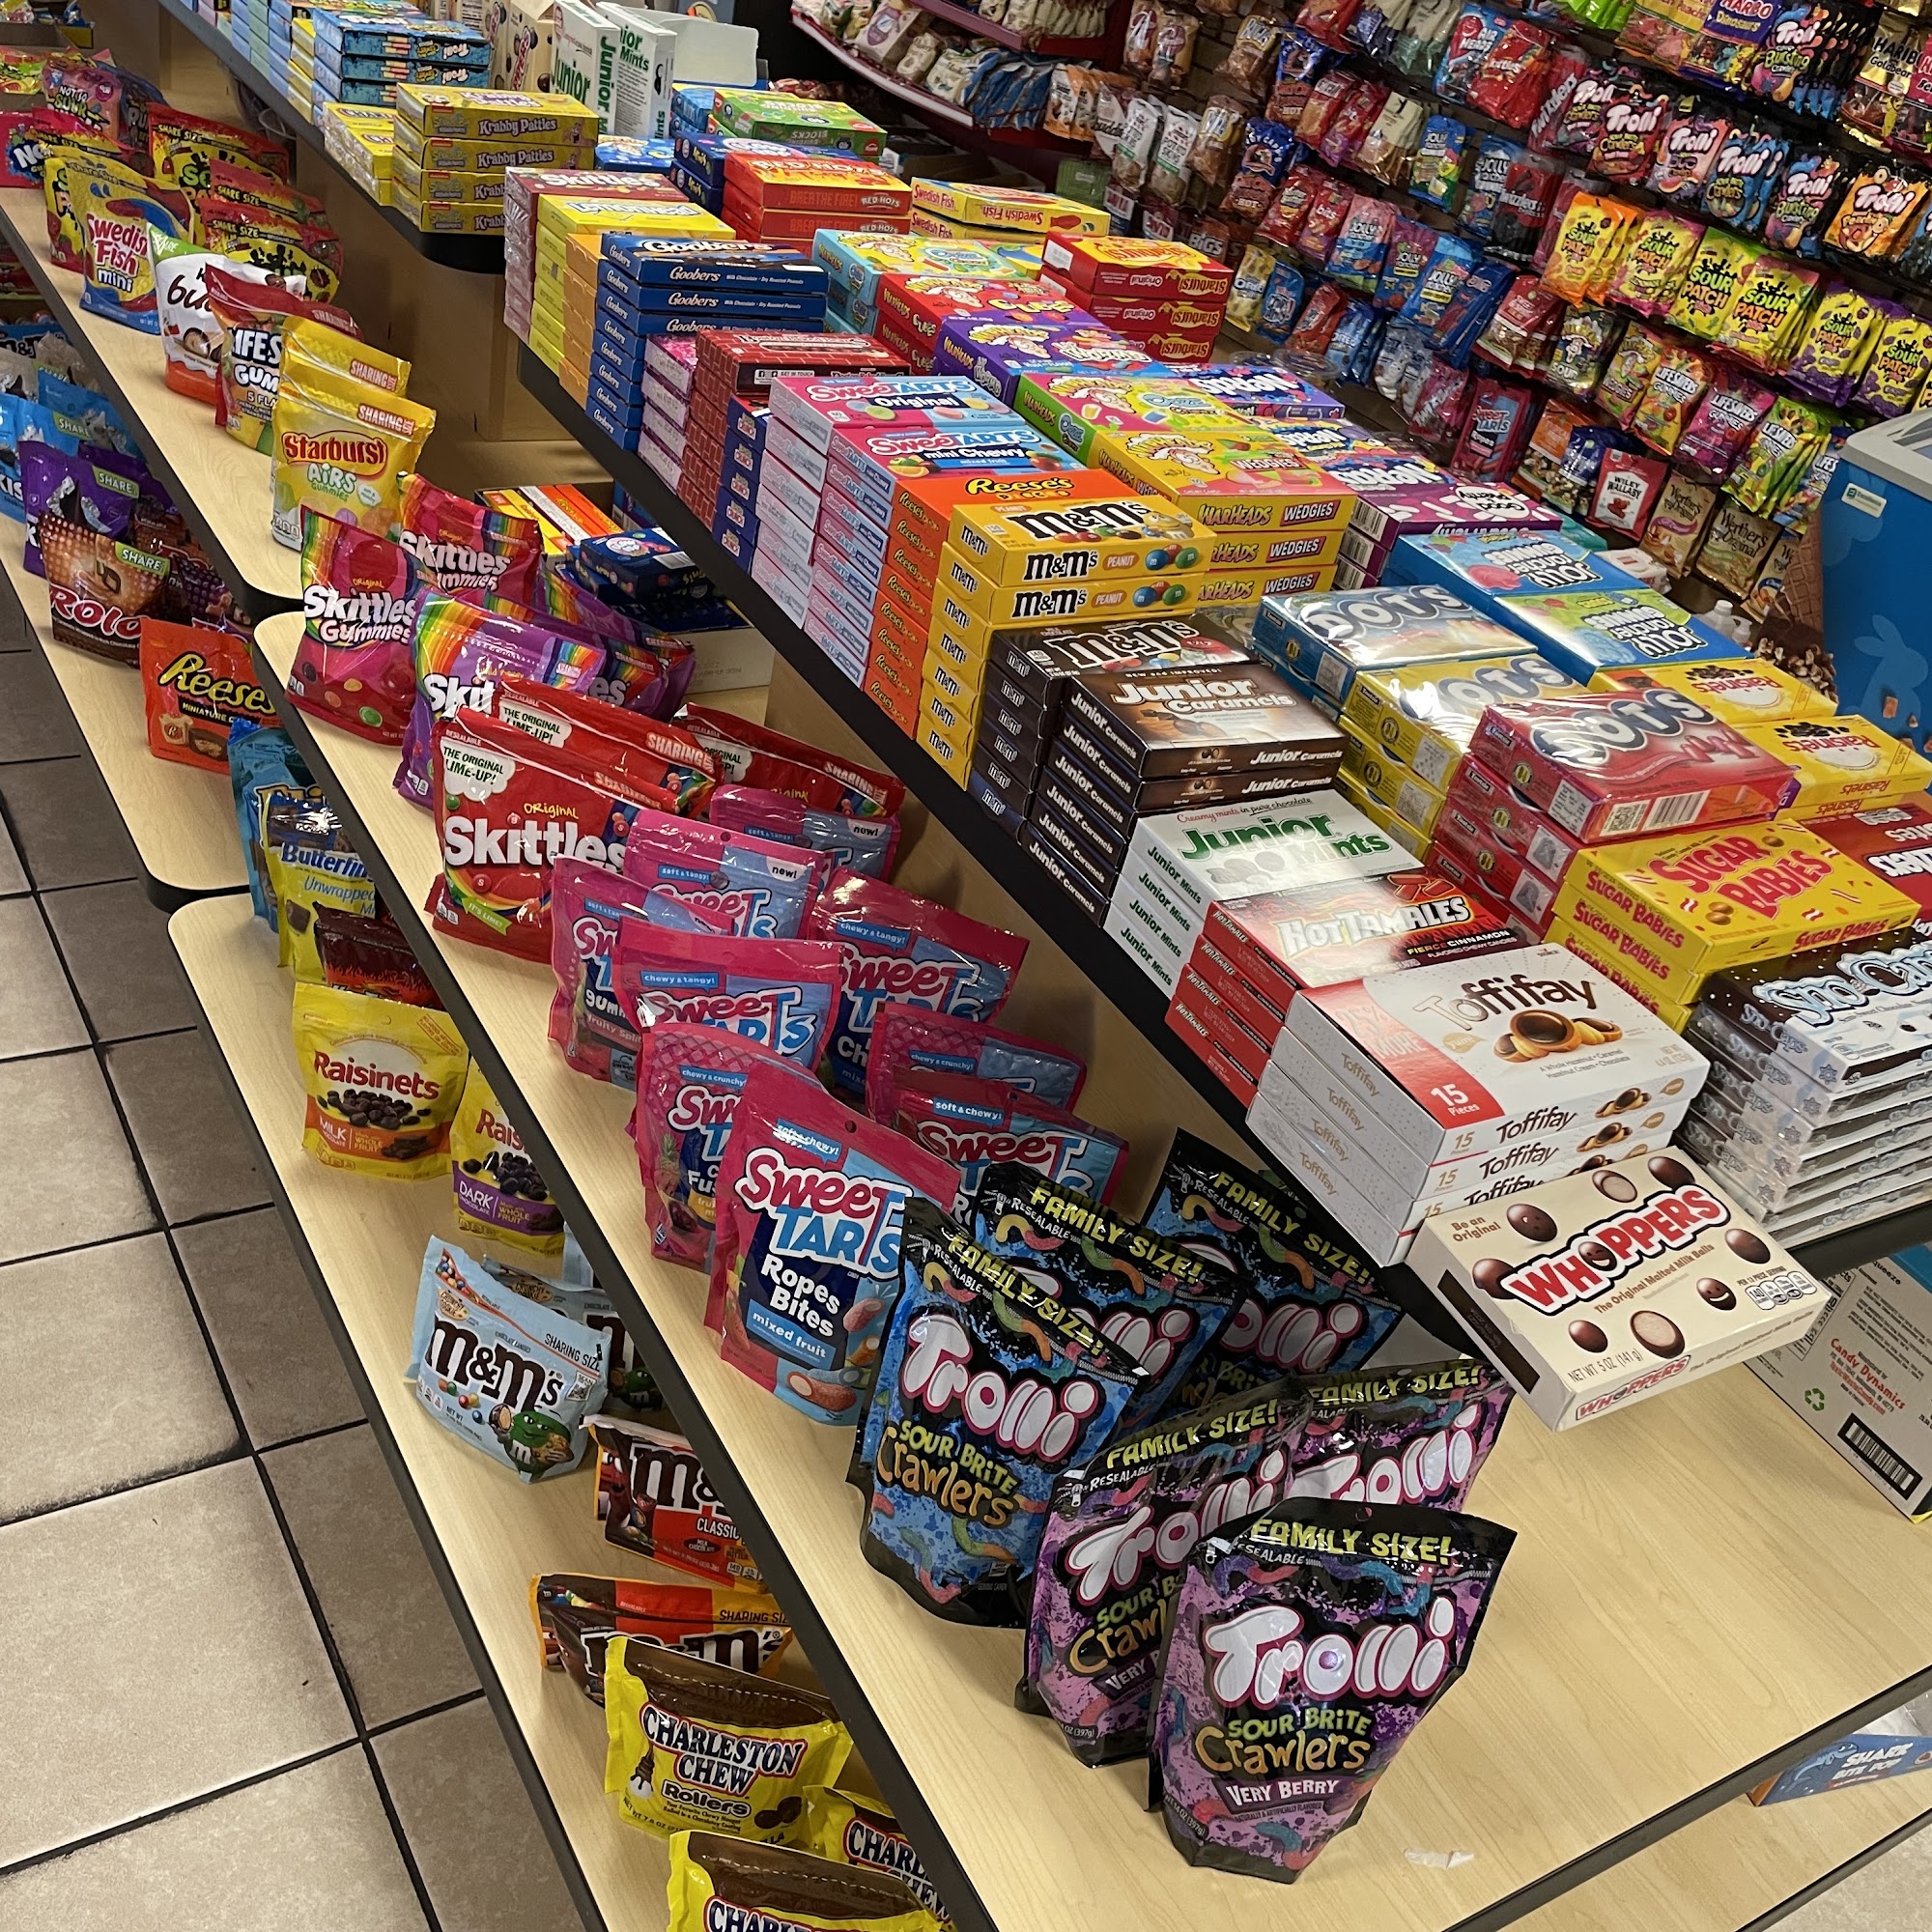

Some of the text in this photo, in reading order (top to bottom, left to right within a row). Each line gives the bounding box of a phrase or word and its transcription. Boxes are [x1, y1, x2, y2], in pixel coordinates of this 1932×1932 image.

[1869, 55, 1912, 78] Goldbear
[478, 120, 519, 136] Krabby
[519, 118, 557, 132] Patties
[477, 150, 554, 168] Krabby Patties
[542, 173, 662, 188] Skittles
[914, 185, 954, 210] Swedish Fish
[97, 242, 138, 278] Fish
[610, 244, 631, 269] Goobers
[98, 268, 133, 294] mini
[607, 270, 629, 294] Goobers
[669, 266, 721, 282] Goobers
[1691, 267, 1733, 293] SOUR
[668, 292, 719, 307] Goobers
[1682, 284, 1728, 308] PATCH
[1744, 291, 1791, 312] SOUR
[1737, 304, 1784, 327] PATCH
[874, 395, 959, 410] Original
[358, 404, 404, 432] SHARING
[283, 433, 386, 466] Starburst
[925, 443, 1029, 461] mini Chewy
[99, 471, 133, 495] SHARE
[1198, 502, 1334, 527] WARHEADS WEDGIES
[121, 549, 161, 572] SHARE
[399, 529, 513, 574] Skittles
[1107, 554, 1136, 568] PEANUT
[1270, 540, 1320, 558] WEDGIES
[1264, 575, 1314, 593] WEDGIES
[304, 584, 416, 625] Skittles
[1094, 593, 1123, 606] PEANUT
[1112, 679, 1257, 704] Junior
[503, 706, 562, 735] THE ORIGINAL
[443, 746, 504, 775] THE ORIGINAL
[648, 733, 704, 767] SHARING
[1250, 748, 1301, 764] Junior
[1242, 778, 1291, 794] Junior
[1217, 808, 1239, 819] mints
[444, 816, 626, 867] Skittles
[1178, 812, 1338, 862] Junior
[1148, 845, 1203, 905] Junior Mints
[1647, 836, 1772, 894] SUGAR
[1717, 849, 1834, 919] BABIES
[1585, 868, 1686, 949] SUGAR BABIES
[839, 922, 870, 937] chewy
[1407, 928, 1511, 955] FIERCE CINNAMON
[1793, 919, 1889, 952] SUGAR BABIES
[644, 974, 716, 987] chewy tangy!
[1412, 973, 1600, 1033] Toffifay
[314, 1051, 440, 1100] Raisinets
[682, 1068, 707, 1080] chewy
[1431, 1084, 1470, 1108] 15
[1447, 1101, 1481, 1117] Pieces
[936, 1101, 1003, 1121] soft chewy!
[1496, 1107, 1577, 1143] Toffifay
[319, 1115, 347, 1141] MILK
[1480, 1142, 1559, 1180] Toffifay
[459, 1180, 494, 1209] DARK
[1030, 1184, 1205, 1286] FAMILY SIZE!
[1213, 1171, 1371, 1285] FAMILY SIZE!
[1451, 1216, 1486, 1232] Be an
[1453, 1223, 1502, 1243] Original
[947, 1236, 1037, 1306] FAMILY
[1594, 1243, 1716, 1315] The Original Malted Milk Balls
[760, 1255, 840, 1316] Ropes
[769, 1287, 835, 1338] Bites
[544, 1333, 582, 1362] SHARING
[753, 1312, 827, 1359] mixed fruit
[1568, 1366, 1584, 1382] NET
[1584, 1363, 1599, 1378] WT
[1604, 1356, 1617, 1370] OZ
[1830, 1338, 1860, 1368] Candy
[1860, 1362, 1906, 1410] Dynamics
[904, 1313, 1098, 1459] Trolli
[899, 1419, 954, 1460] SOUR
[1107, 1399, 1278, 1470] FAMILY SIZE!
[876, 1425, 1015, 1526] Crawlers
[1252, 1518, 1452, 1565] FAMILY SIZE!
[719, 1609, 769, 1622] SHARING
[1096, 1588, 1154, 1630] SOUR
[1203, 1597, 1456, 1706] Trolli
[1105, 1660, 1145, 1692] VERY
[641, 1706, 807, 1777] CHARLESTON
[1227, 1713, 1293, 1742] SOUR
[1194, 1724, 1373, 1776] Crawlers
[1841, 1743, 1914, 1768] SHARK
[678, 1755, 754, 1794] CHEW
[664, 1781, 750, 1817] Rollers
[1225, 1779, 1341, 1806] VERY BERRY
